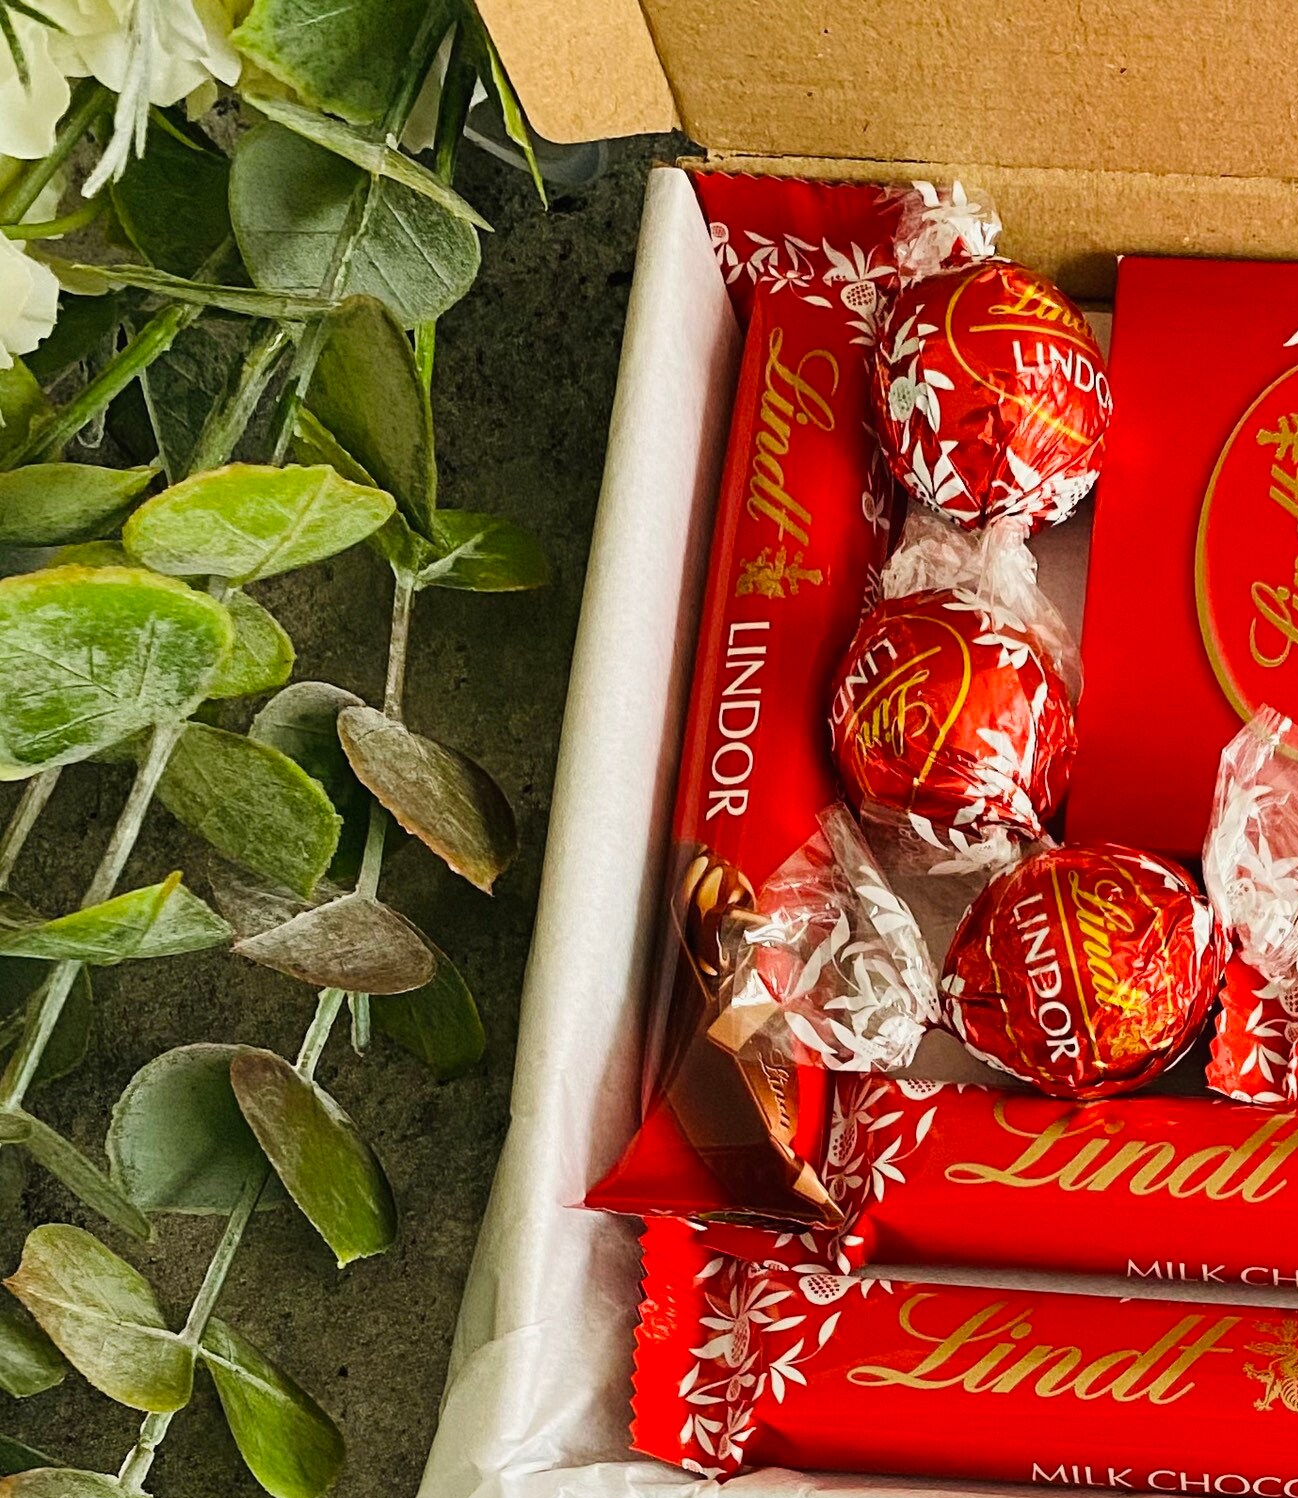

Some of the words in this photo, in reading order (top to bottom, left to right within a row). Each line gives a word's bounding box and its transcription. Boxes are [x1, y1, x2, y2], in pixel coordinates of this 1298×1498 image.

[1012, 341, 1113, 412] LINDO
[747, 328, 840, 545] Lindt
[706, 621, 770, 821] LINDOR
[828, 637, 898, 750] LIND
[1013, 893, 1081, 1063] LINDOR
[1126, 1258, 1226, 1284] MILK
[846, 1291, 1243, 1405] Lindt
[1031, 1462, 1133, 1488] MILK
